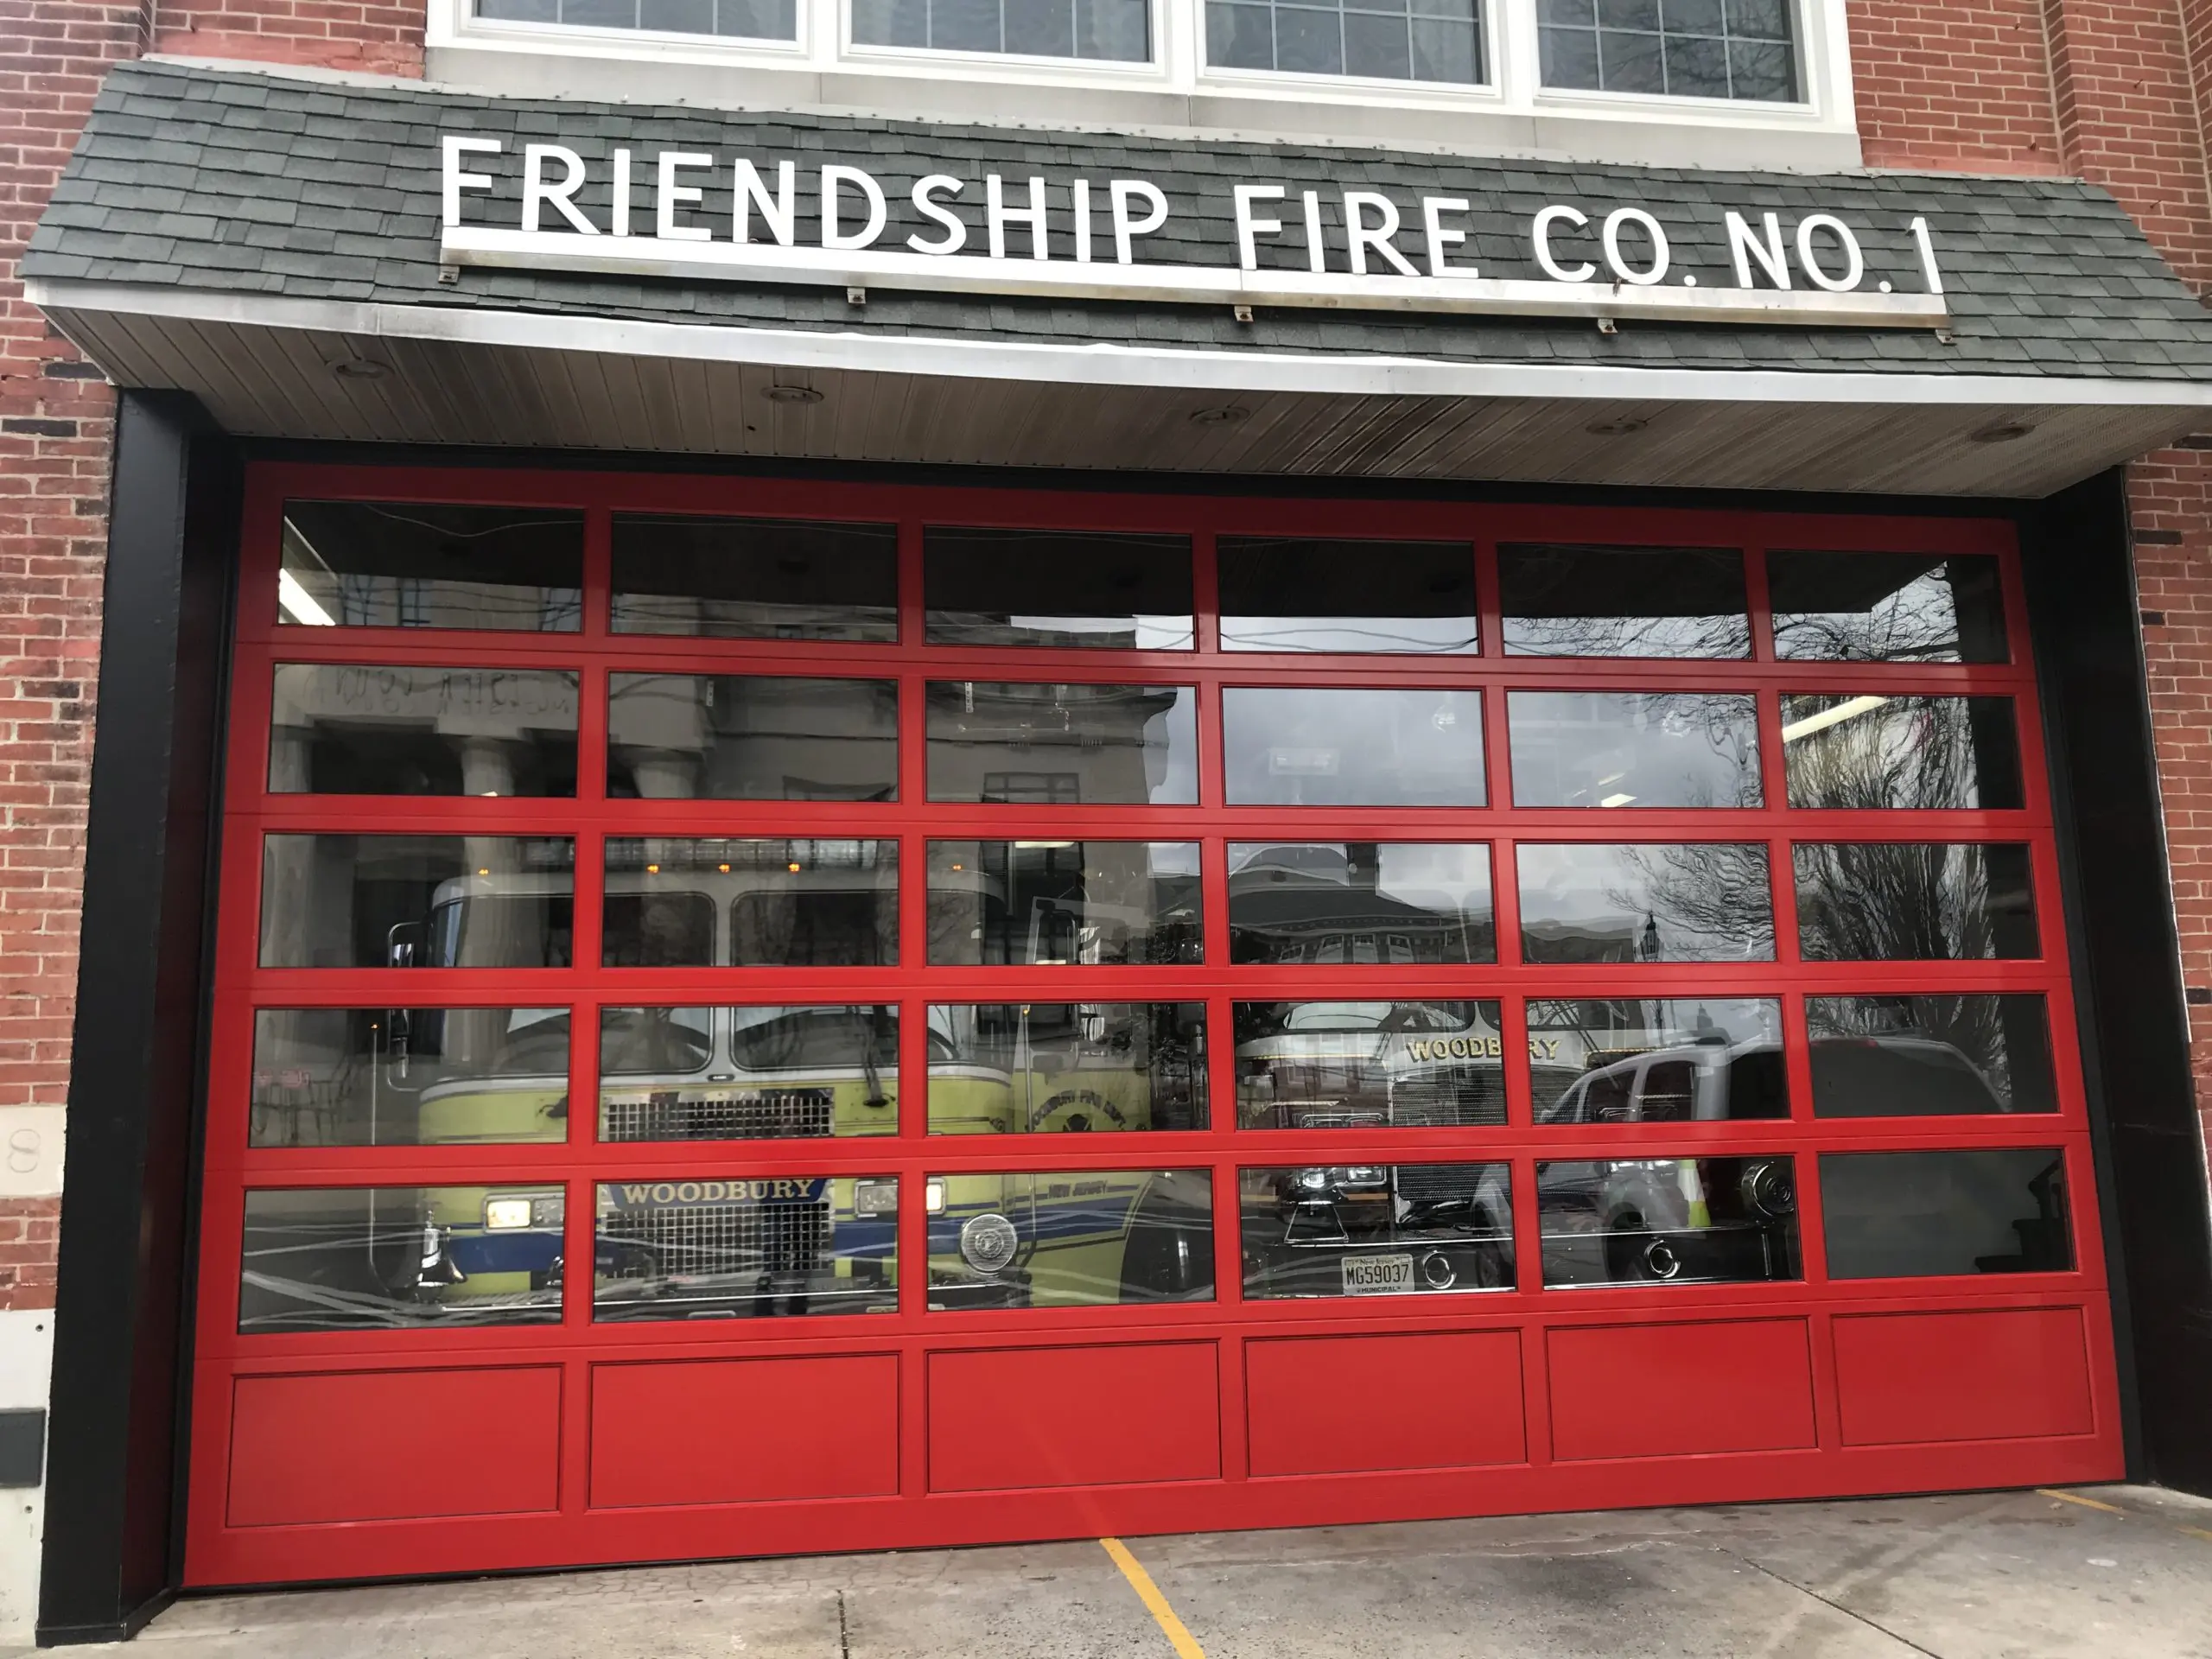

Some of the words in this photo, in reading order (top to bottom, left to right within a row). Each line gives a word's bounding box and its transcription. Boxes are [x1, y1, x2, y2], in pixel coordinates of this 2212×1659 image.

[442, 135, 1169, 265] FRIENDSHIP
[1233, 184, 1480, 278] FIRE
[1532, 204, 1697, 288] CO.
[1406, 1037, 1561, 1063] WOODBRY
[8, 1128, 41, 1173] 8
[621, 1179, 817, 1205] WOODBURY
[1346, 1263, 1409, 1286] MG59037
